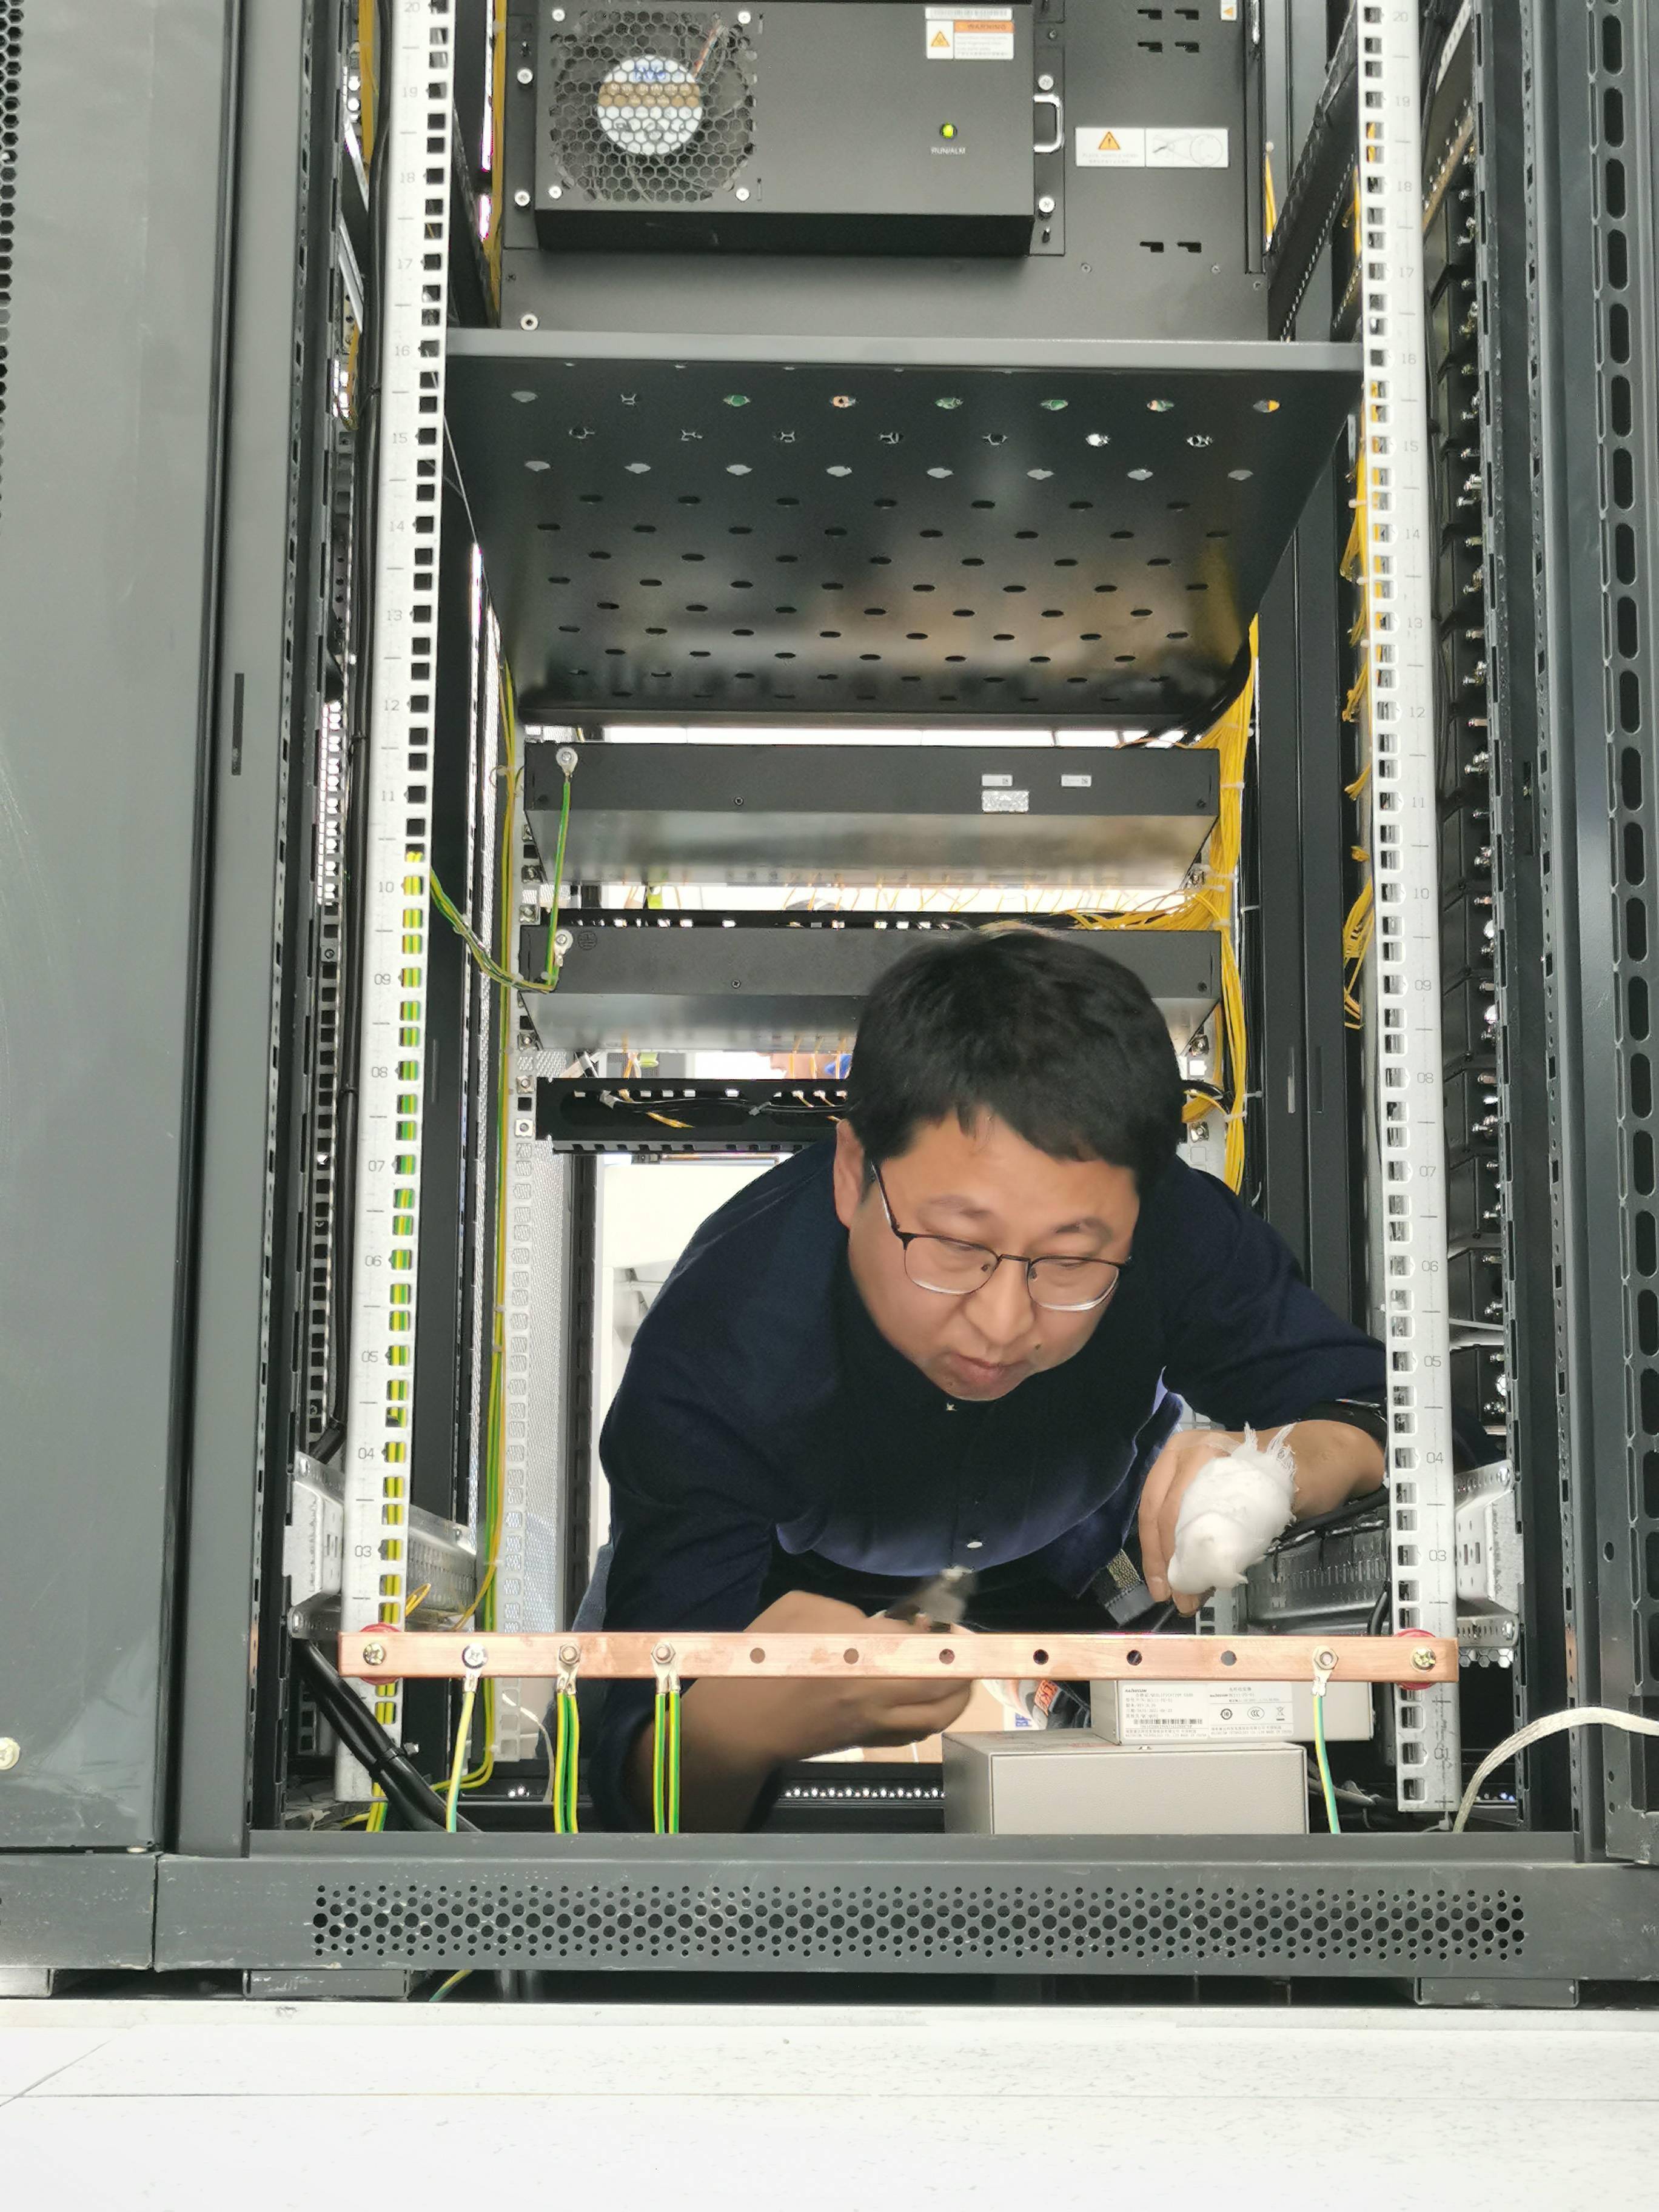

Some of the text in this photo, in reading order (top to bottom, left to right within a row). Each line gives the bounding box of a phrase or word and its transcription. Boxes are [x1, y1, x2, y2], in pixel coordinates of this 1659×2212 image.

[404, 2, 420, 13] 20
[1393, 11, 1409, 22] 20
[403, 87, 417, 98] 19
[1396, 96, 1410, 107] 19
[400, 172, 415, 183] 18
[1398, 181, 1412, 192] 18
[398, 258, 412, 270] 17
[1399, 267, 1414, 278] 17
[395, 346, 409, 357] 16
[1403, 353, 1416, 364] 16
[393, 433, 407, 443] 15
[1405, 440, 1418, 452] 15
[390, 521, 404, 532] 14
[1407, 529, 1420, 539] 14
[387, 610, 402, 621] 13
[1409, 617, 1423, 629] 13
[384, 700, 399, 711] 12
[1411, 707, 1425, 718] 12
[382, 790, 394, 801] 11
[1413, 797, 1424, 808] 11
[379, 882, 394, 893] 10
[1415, 888, 1429, 899] 10
[374, 973, 390, 985] 09
[1415, 980, 1432, 991] 09
[371, 1067, 387, 1078] 08
[1417, 1073, 1434, 1084] 08
[368, 1160, 384, 1171] 07
[1419, 1166, 1436, 1177] 07
[365, 1255, 381, 1266] 06
[1422, 1261, 1438, 1272] 06
[361, 1350, 378, 1362] 05
[1424, 1356, 1441, 1367] 05
[358, 1447, 374, 1459] 04
[1427, 1452, 1444, 1463] 04
[355, 1545, 372, 1557] 03
[1429, 1550, 1447, 1561] 03
